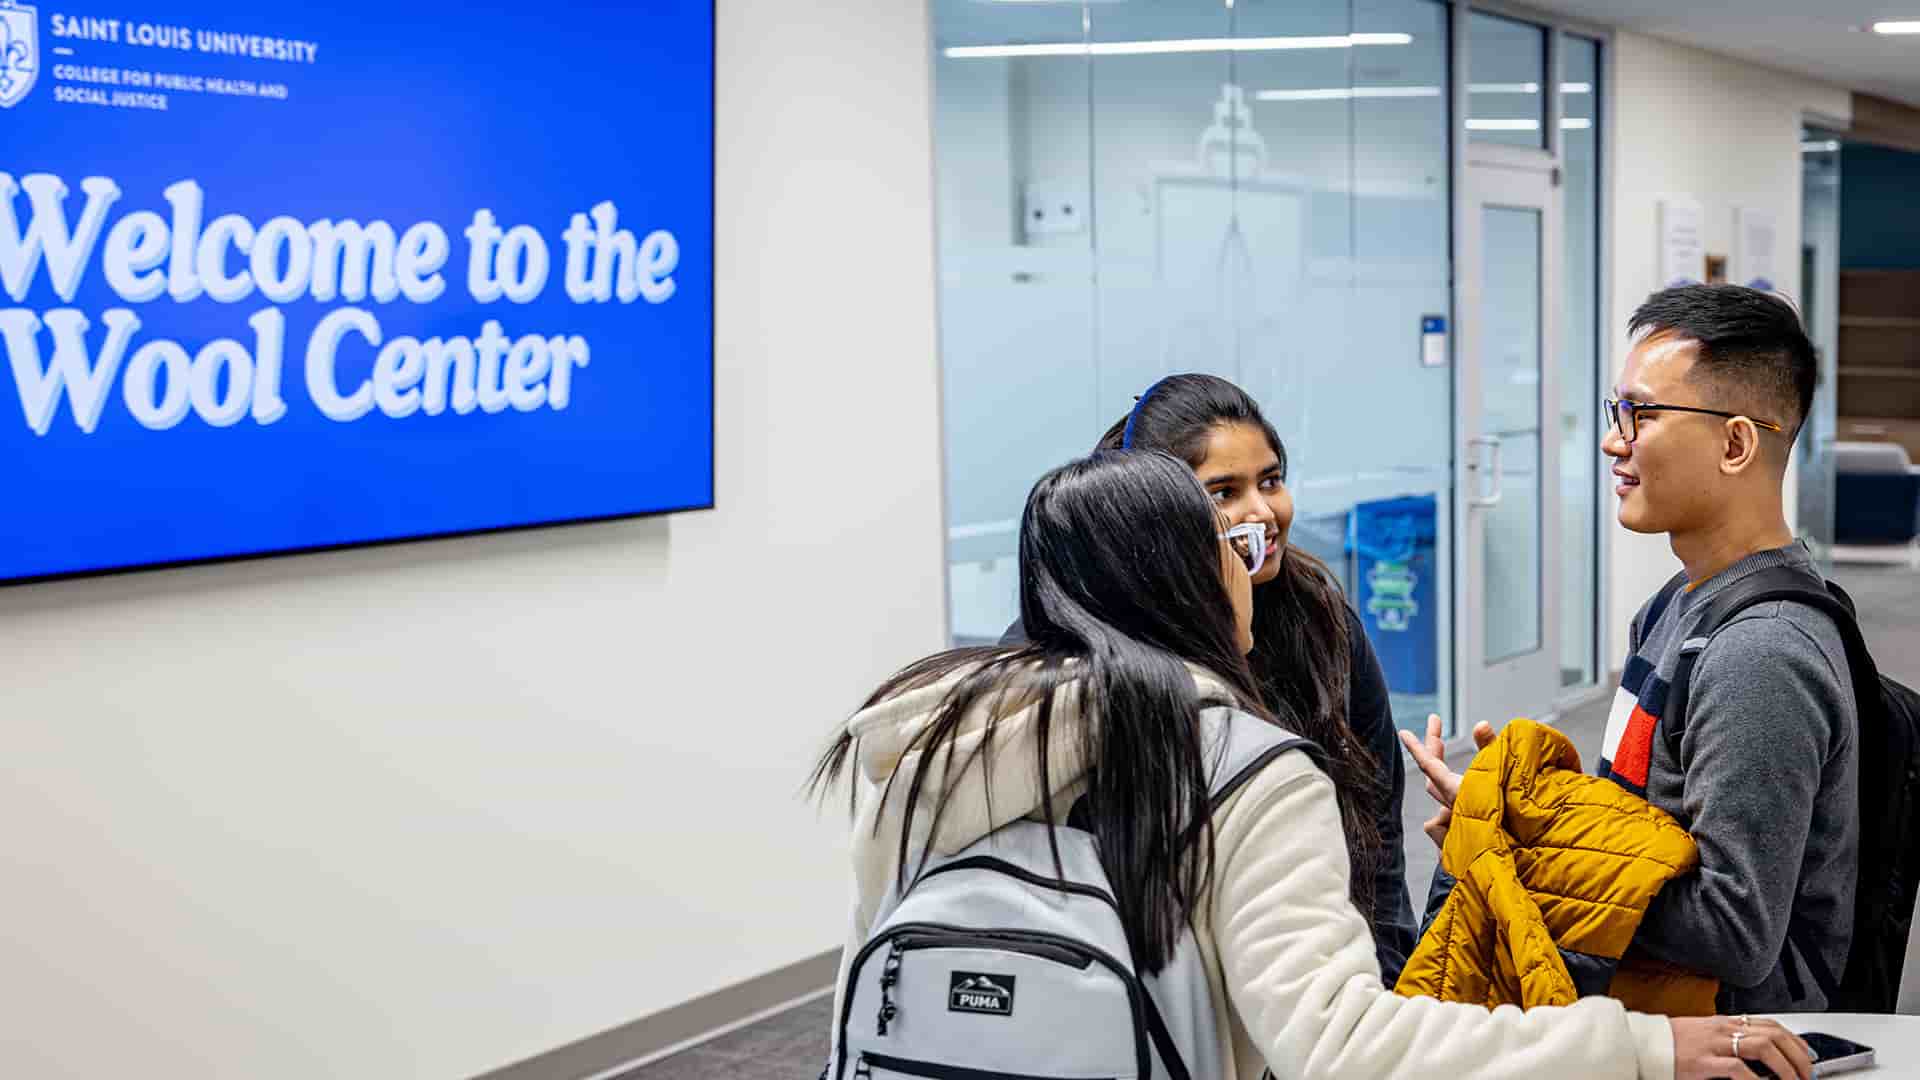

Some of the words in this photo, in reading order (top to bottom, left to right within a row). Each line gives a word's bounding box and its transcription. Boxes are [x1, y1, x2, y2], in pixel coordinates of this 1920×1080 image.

[51, 13, 120, 43] SAINT
[125, 21, 193, 50] LOUIS
[196, 29, 318, 64] UNIVERSITY
[53, 64, 119, 84] COLLEGE
[122, 68, 151, 88] FOR
[154, 72, 204, 92] PUBLIC
[258, 83, 289, 100] AND
[54, 86, 109, 106] SOCIAL
[0, 172, 450, 303] Welcome
[465, 208, 550, 303] to
[562, 200, 680, 303] the
[0, 307, 288, 437] Wool
[305, 307, 590, 422] Center
[959, 994, 1000, 1009] PUMA
